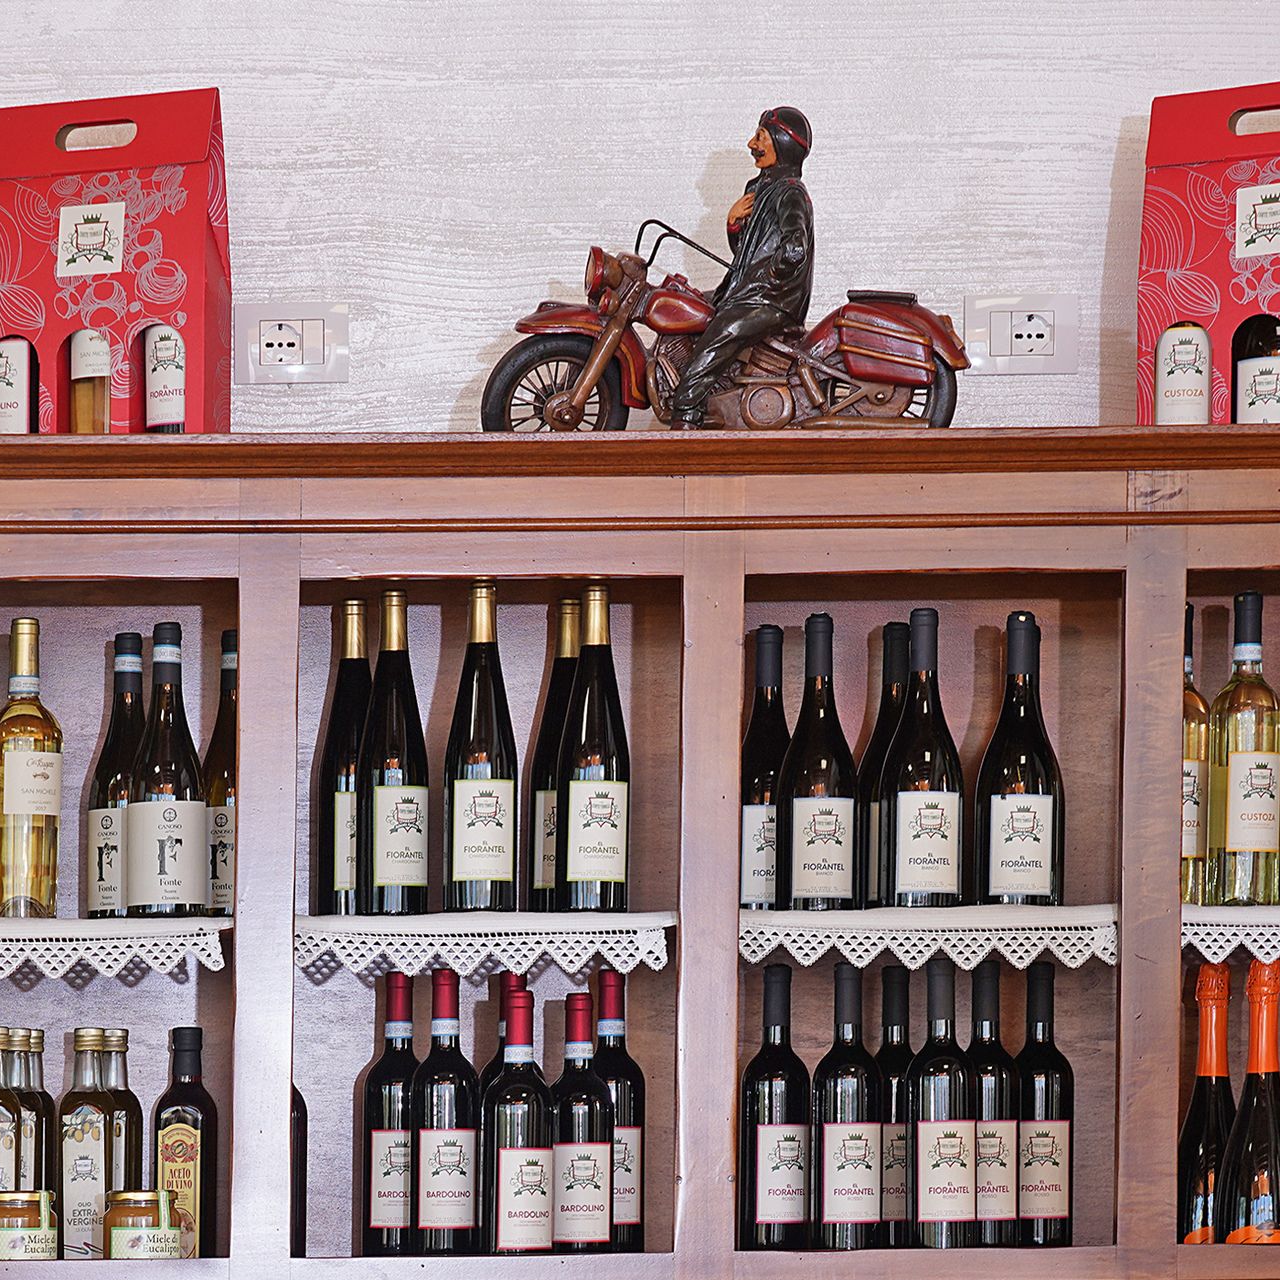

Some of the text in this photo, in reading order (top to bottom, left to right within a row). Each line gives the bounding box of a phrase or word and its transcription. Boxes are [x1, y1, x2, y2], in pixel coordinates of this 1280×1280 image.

[1164, 388, 1205, 398] CUSTOZA
[21, 788, 35, 796] SAN
[1240, 813, 1276, 821] CUSTOZA
[463, 846, 505, 854] FIORANTEL
[386, 851, 424, 859] FIORANTEL
[909, 857, 950, 865] FIORANTEL
[1001, 860, 1043, 868] FIORANTEL
[803, 863, 845, 871] FIORANTEL
[753, 869, 775, 877] FIORA
[159, 878, 182, 887] Fonte
[211, 881, 232, 891] Fonte
[98, 884, 118, 893] Fonte
[168, 1168, 192, 1179] ACETO
[167, 1180, 193, 1189] DI VINO
[1021, 1184, 1062, 1192] FIORANTEL
[614, 1187, 636, 1195] OLINO
[768, 1188, 806, 1196] FIORANTEL
[833, 1188, 875, 1196] FIORANTEL
[882, 1187, 906, 1195] FIORA
[928, 1186, 970, 1194] FIORANTEL
[977, 1185, 1010, 1193] ORANTEL
[378, 1190, 410, 1198] BARDOL
[427, 1190, 471, 1198] BARDOLINO
[560, 1204, 606, 1212] BARDOLINO
[72, 1209, 97, 1217] EXTRA
[508, 1211, 550, 1219] BARDOLINO
[66, 1218, 104, 1226] VERGINE
[28, 1234, 48, 1244] Miele
[146, 1234, 170, 1244] Miele
